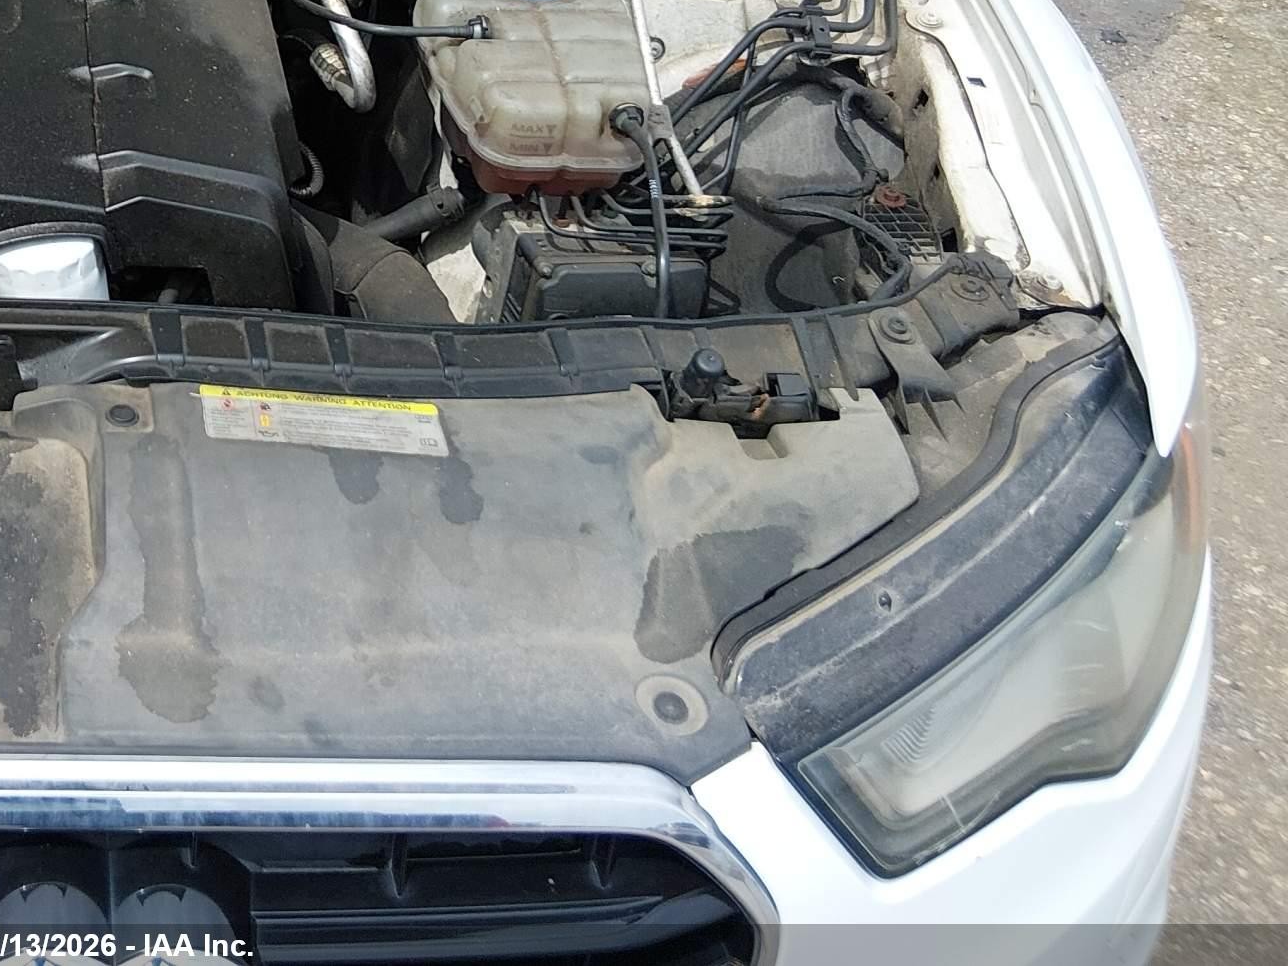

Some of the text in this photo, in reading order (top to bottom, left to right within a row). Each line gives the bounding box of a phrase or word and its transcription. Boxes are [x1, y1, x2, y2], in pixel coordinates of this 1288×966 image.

[511, 123, 544, 133] MAX
[509, 142, 539, 152] MIN
[236, 390, 412, 411] ACHTUNG WARNING ATTENTION
